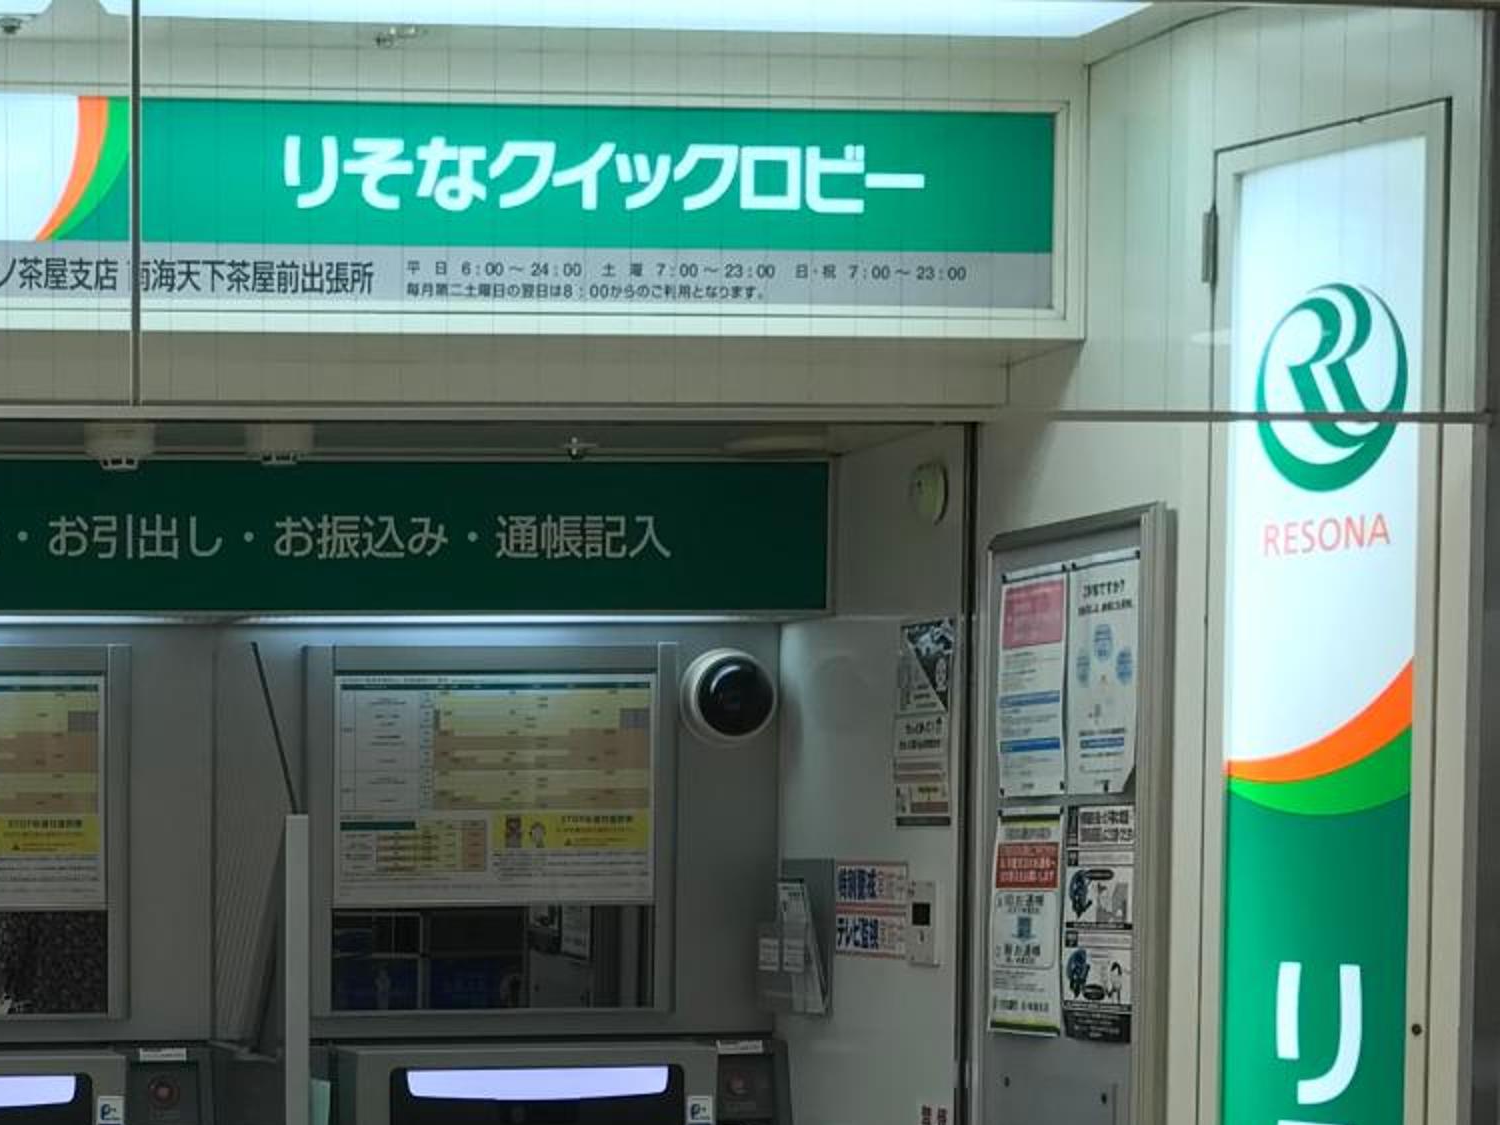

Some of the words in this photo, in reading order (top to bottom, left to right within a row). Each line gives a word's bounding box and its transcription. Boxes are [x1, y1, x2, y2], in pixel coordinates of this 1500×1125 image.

[282, 133, 925, 213] りそなクイックロビー
[1262, 511, 1392, 559] RESONA
